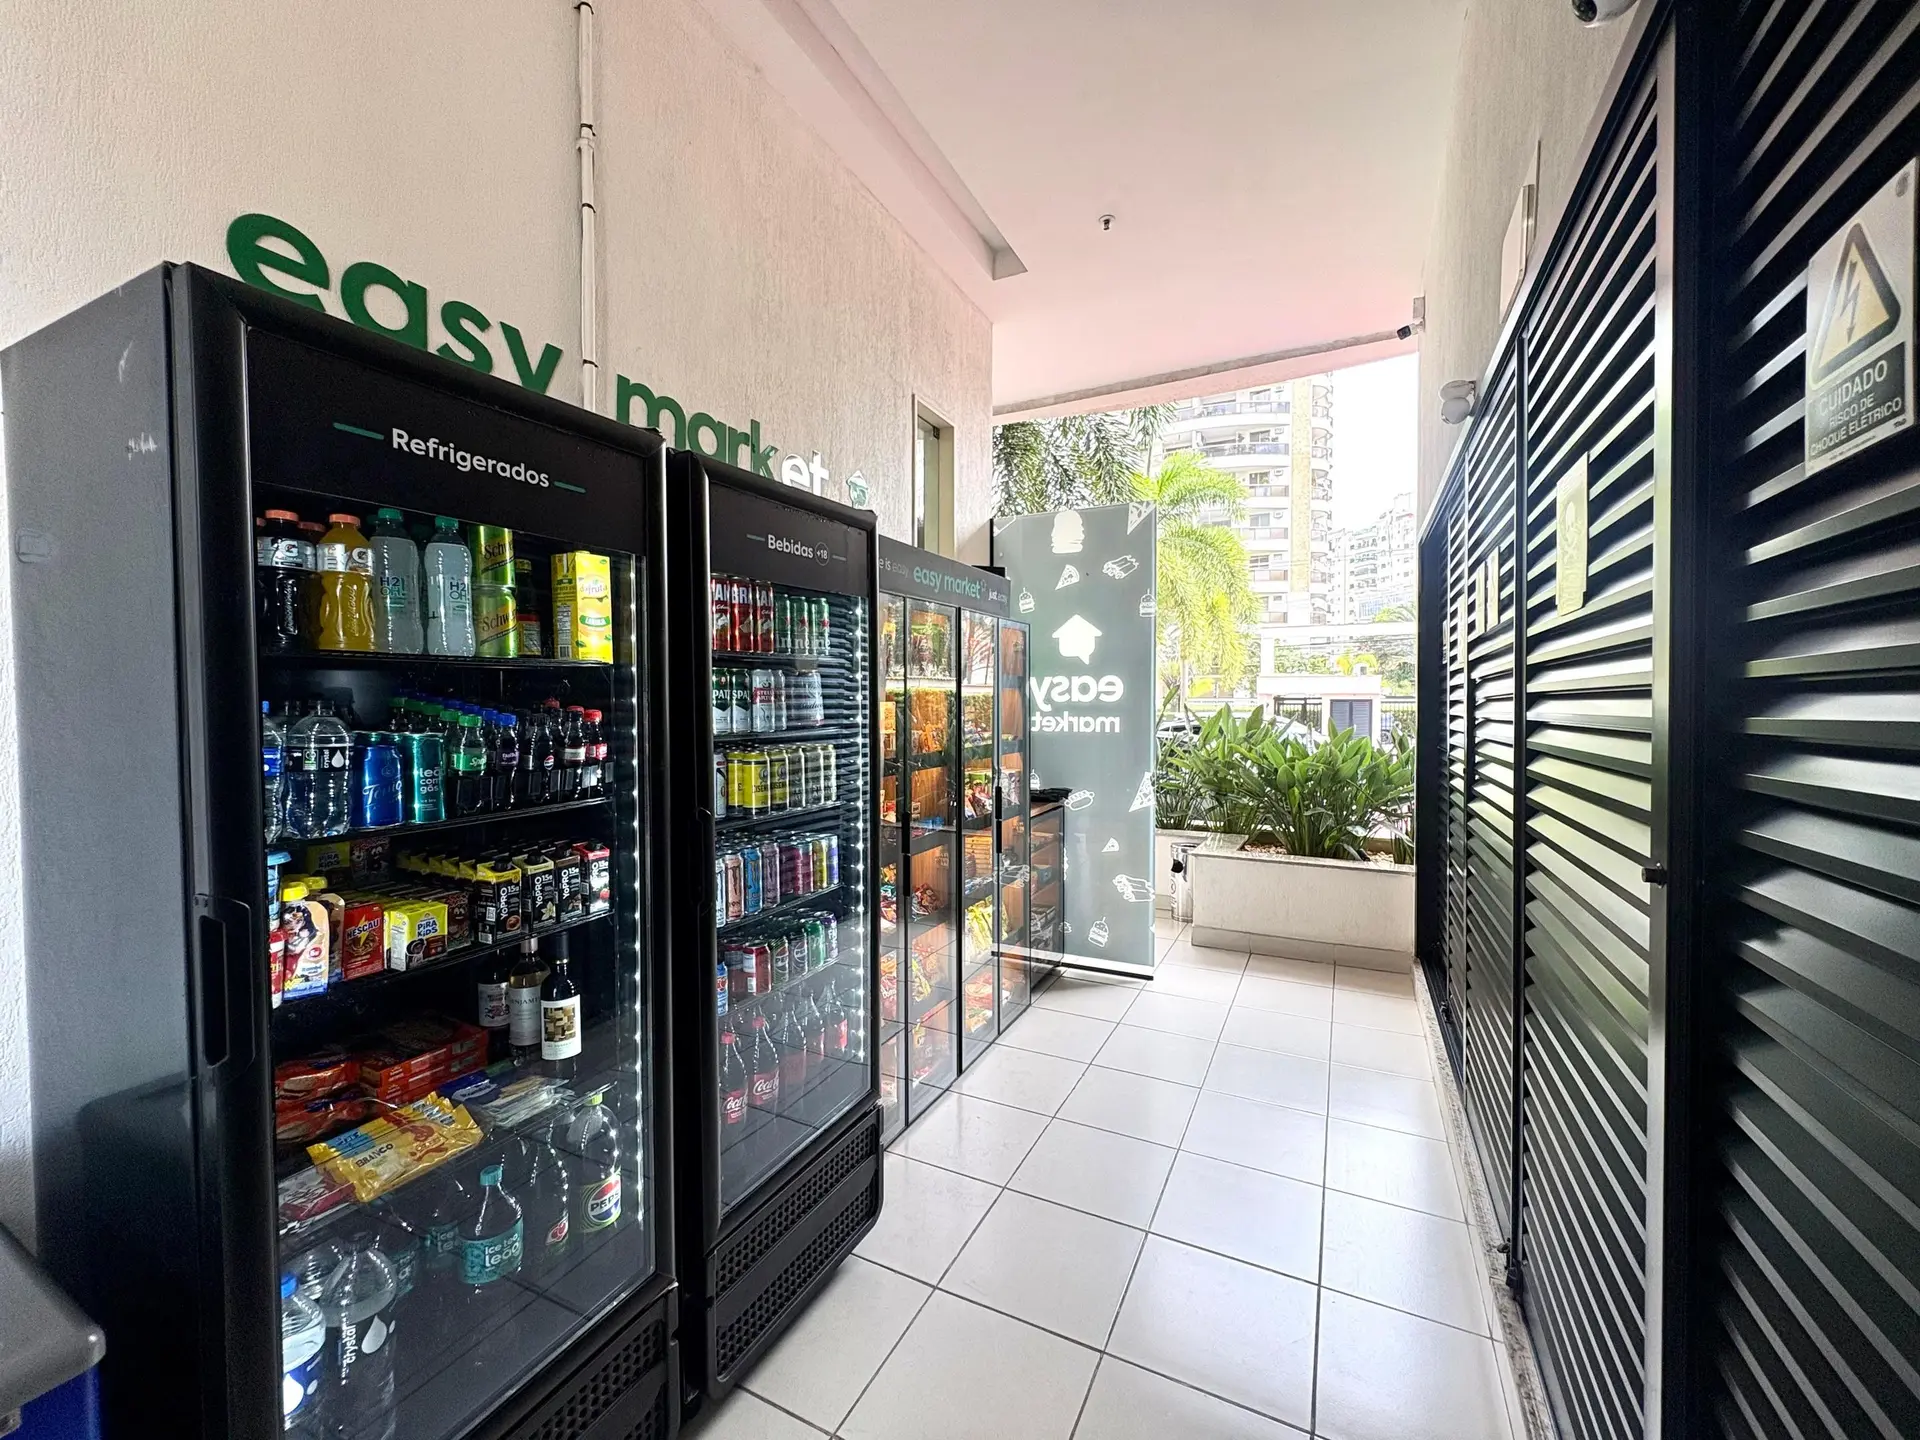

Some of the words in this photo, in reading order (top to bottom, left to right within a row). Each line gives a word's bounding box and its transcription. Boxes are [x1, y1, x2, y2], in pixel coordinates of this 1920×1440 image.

[226, 213, 563, 395] easy
[617, 374, 829, 496] market
[1820, 360, 1887, 416] CUIDADO
[1829, 404, 1858, 430] RISCO
[1860, 393, 1875, 412] DE
[1810, 426, 1847, 456] CHOQUE
[392, 428, 550, 488] Refrigerados
[768, 534, 814, 558] Bebidas
[816, 549, 828, 560] +18
[913, 566, 942, 593] easy
[944, 574, 981, 598] market
[988, 588, 998, 601] just
[346, 919, 380, 939] NESCAU
[355, 1143, 395, 1168] BRANCO
[485, 1243, 502, 1255] Ice
